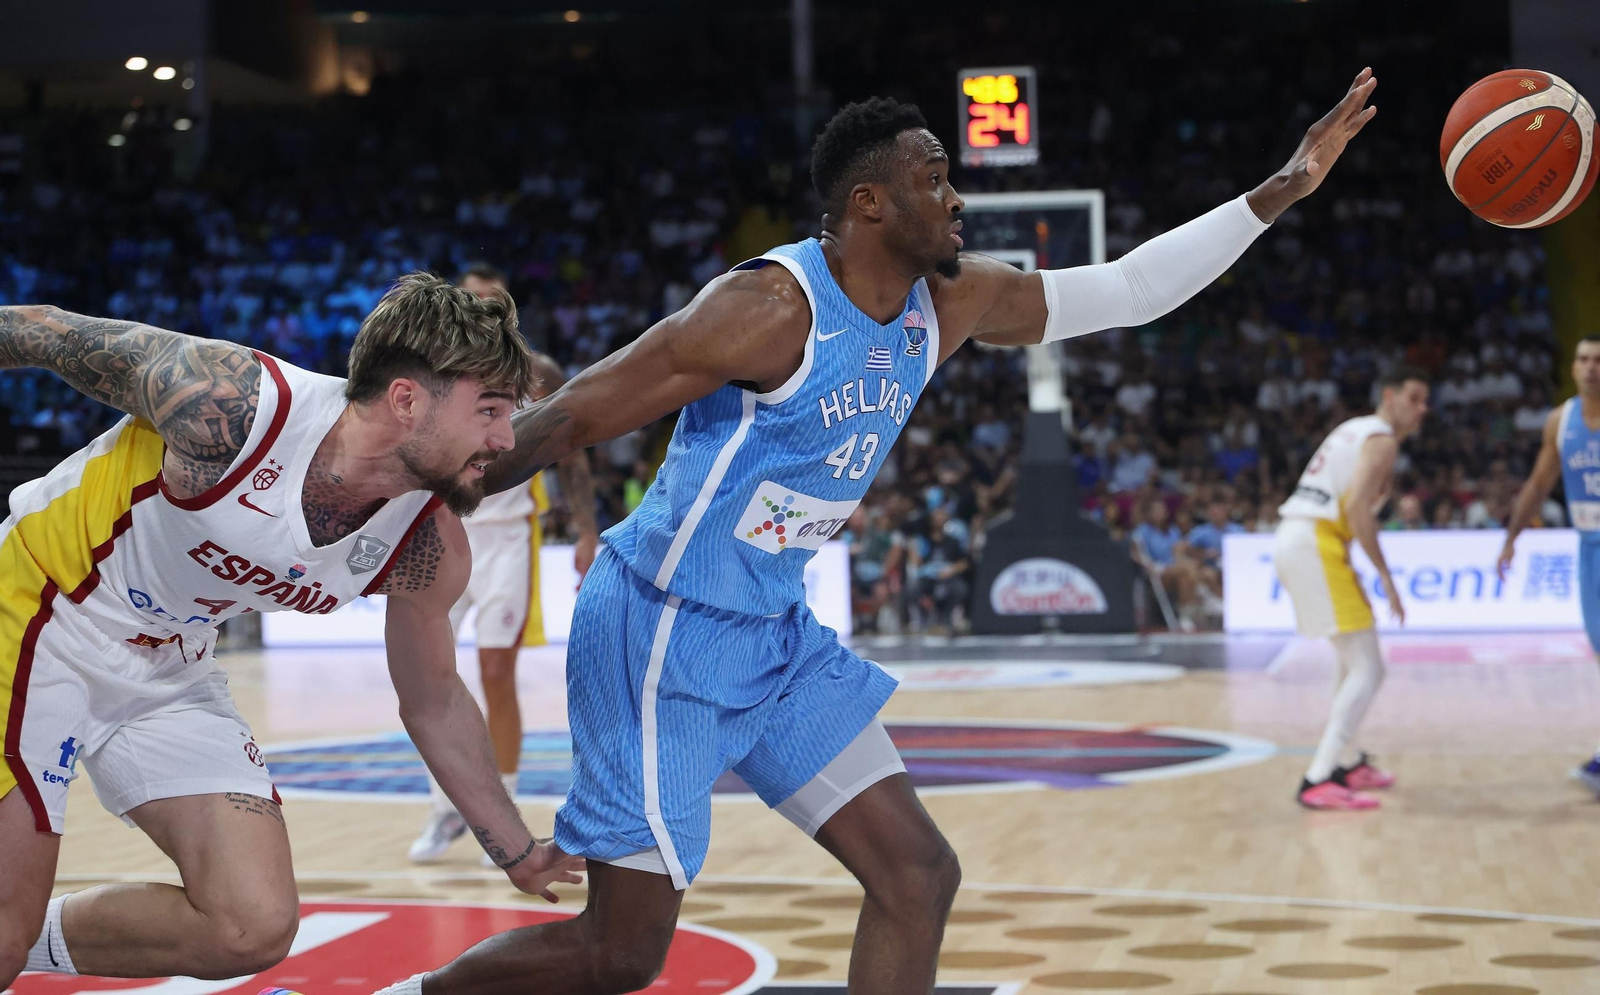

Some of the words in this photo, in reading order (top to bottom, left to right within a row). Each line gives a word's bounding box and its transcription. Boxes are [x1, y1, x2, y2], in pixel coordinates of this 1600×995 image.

[967, 103, 1030, 148] 24
[1482, 154, 1514, 185] FIBA
[1502, 168, 1558, 218] molten
[824, 432, 880, 480] 43
[187, 540, 339, 615] ESPAÑA
